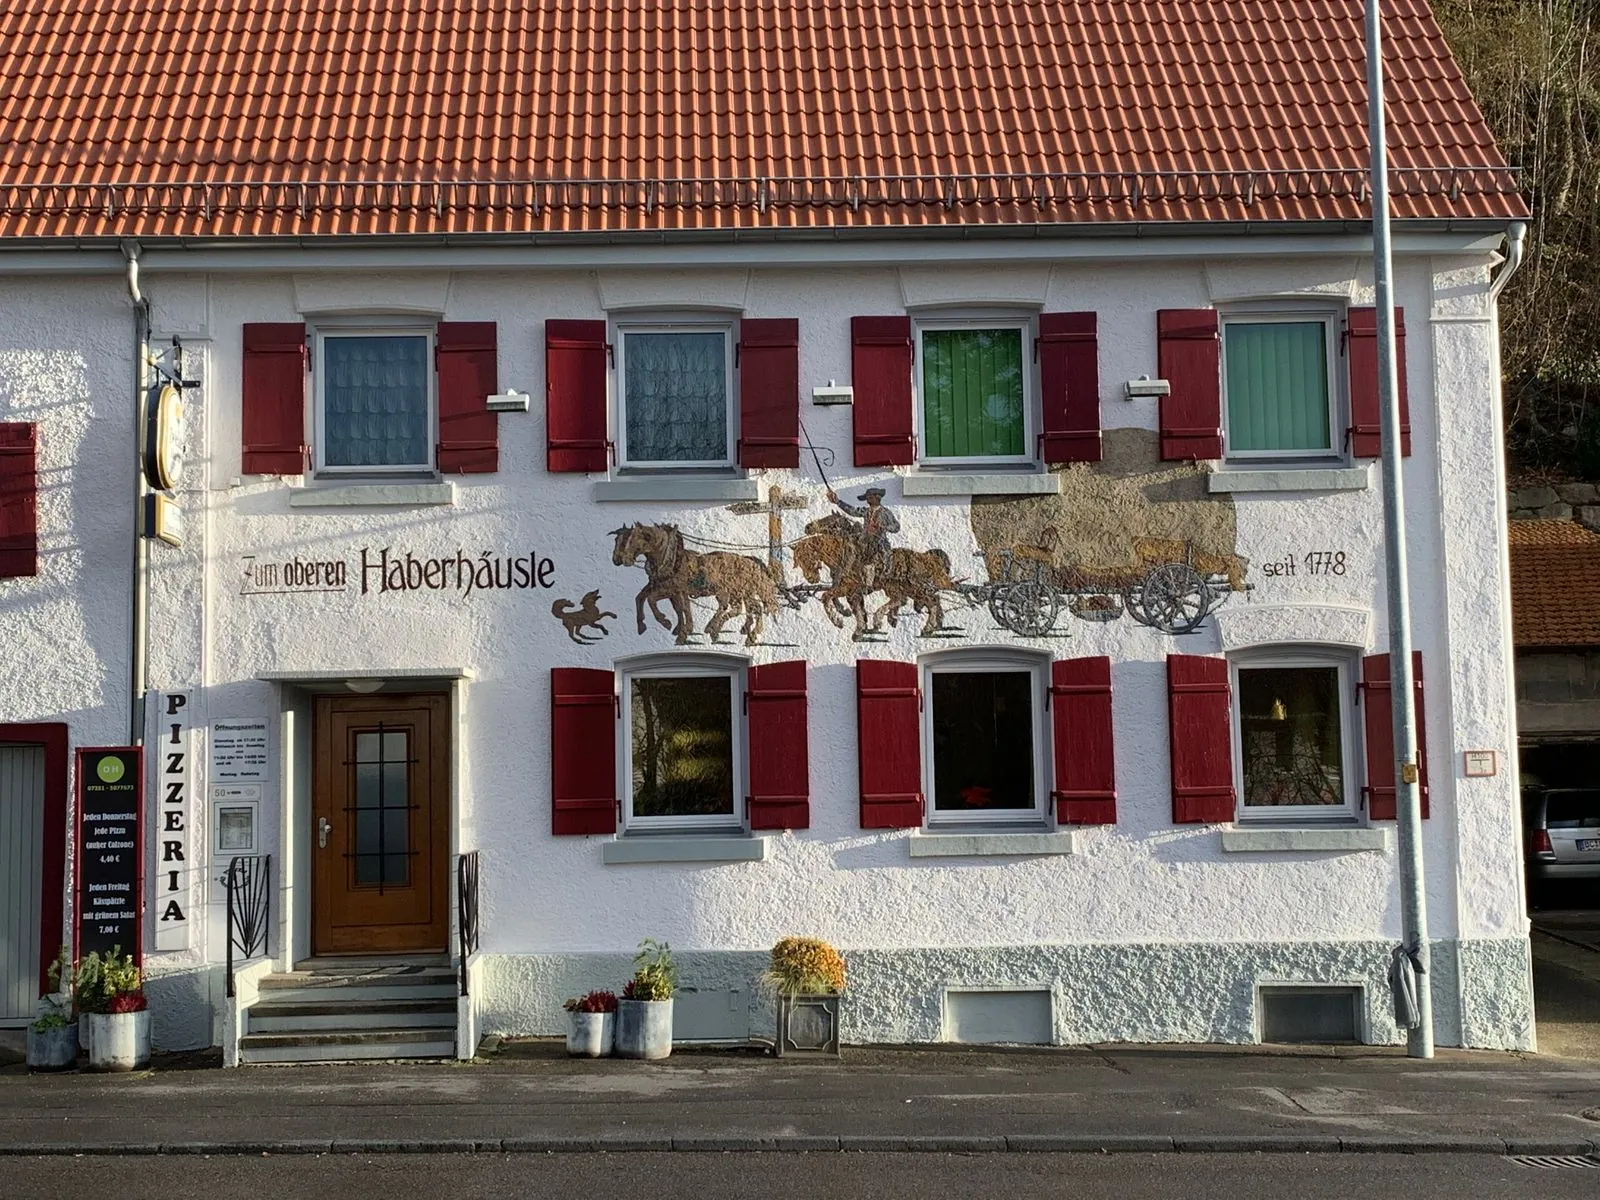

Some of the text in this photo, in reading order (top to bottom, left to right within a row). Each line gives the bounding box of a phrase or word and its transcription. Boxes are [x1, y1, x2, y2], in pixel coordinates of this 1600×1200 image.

[1262, 551, 1346, 577] seit 1778
[240, 547, 555, 599] Zum oberen Haberhäusle
[161, 694, 186, 921] PIZZERIA
[83, 812, 137, 822] Jeden Donnerstag
[109, 826, 126, 834] Pizza
[115, 854, 120, 862] €
[88, 882, 130, 892] Jeden Freitag
[95, 912, 119, 920] grünem
[119, 911, 136, 919] Salat
[114, 925, 120, 933] €
